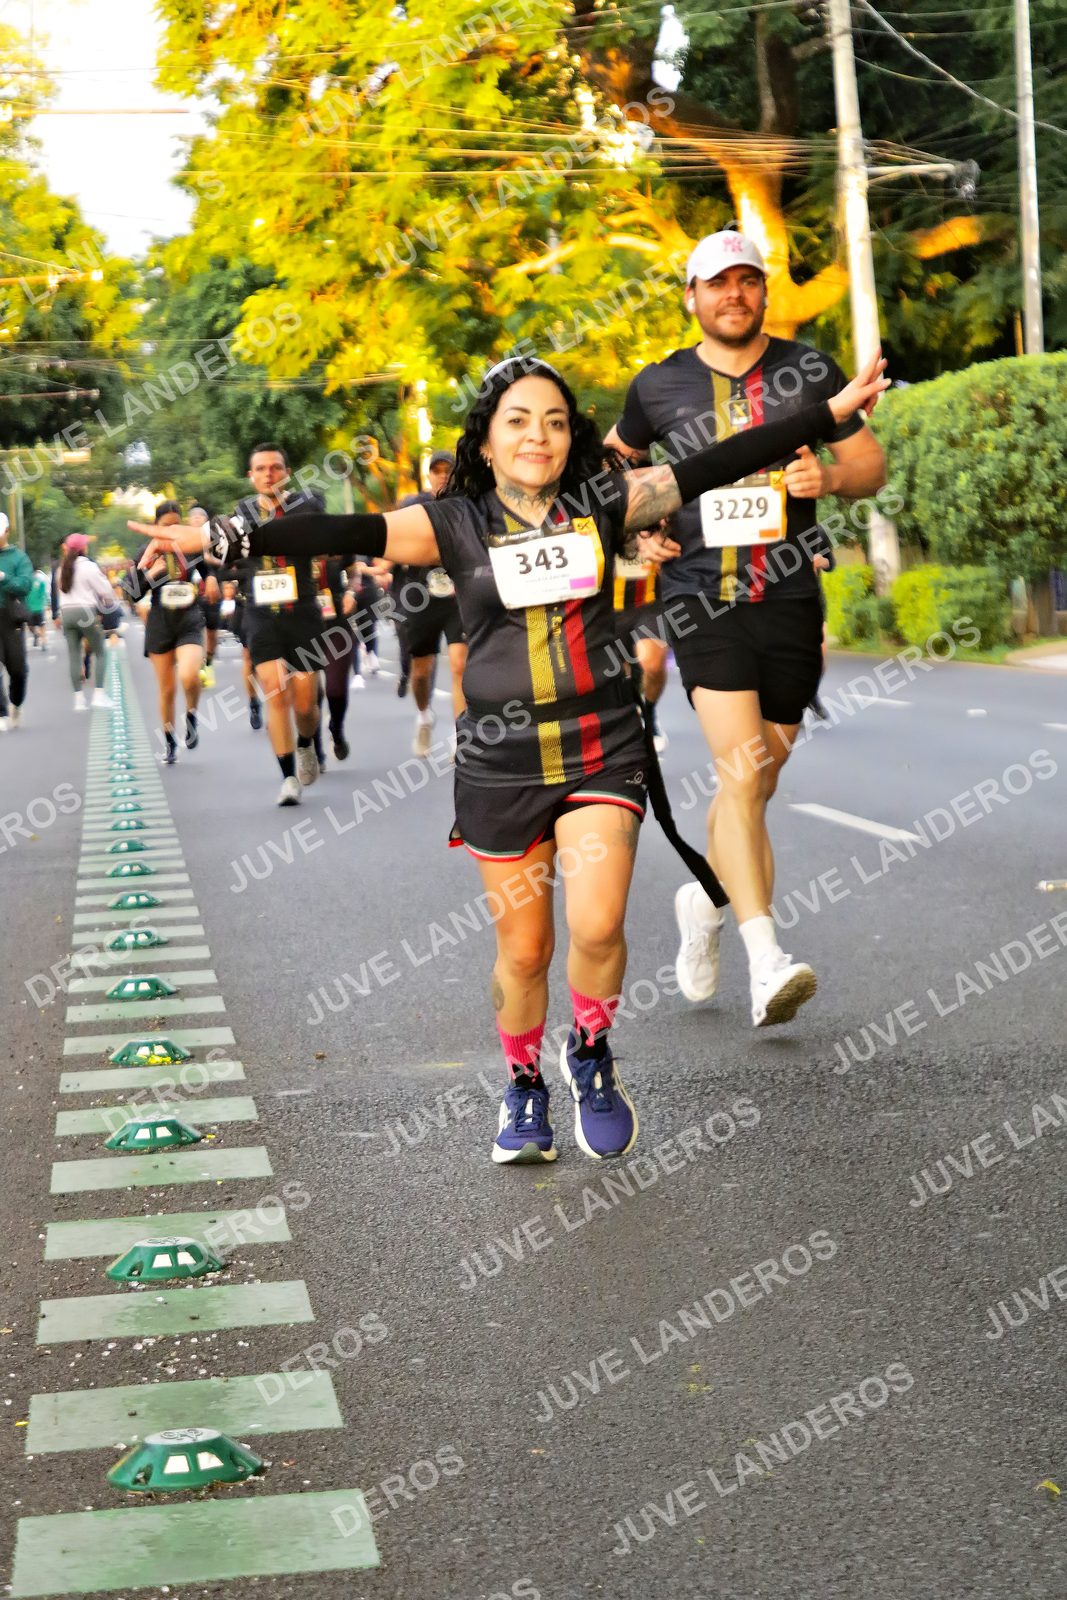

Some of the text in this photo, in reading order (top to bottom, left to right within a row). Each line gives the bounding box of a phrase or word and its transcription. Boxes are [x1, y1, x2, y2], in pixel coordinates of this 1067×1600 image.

[713, 497, 769, 521] 3229
[515, 545, 569, 575] 343
[260, 578, 287, 591] 6279
